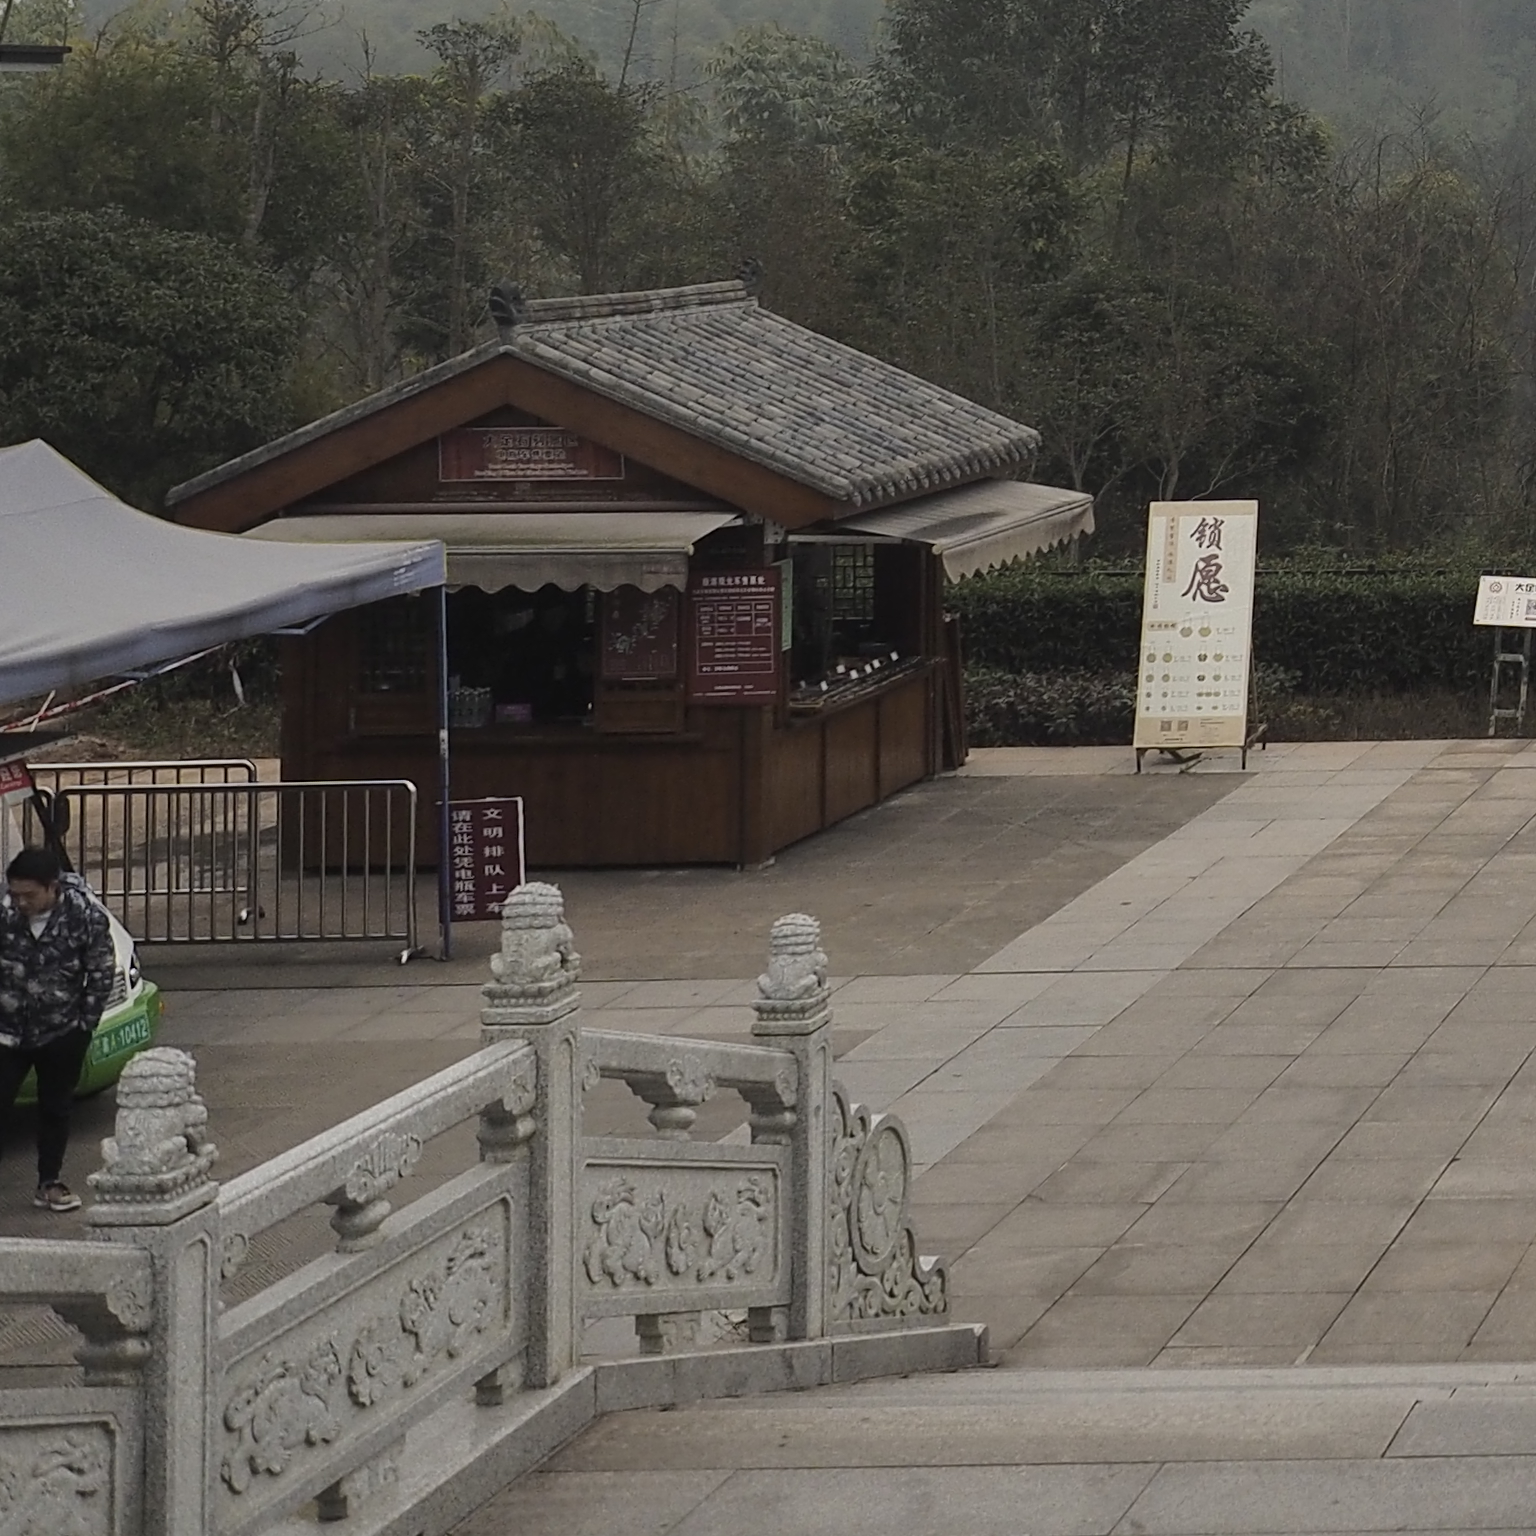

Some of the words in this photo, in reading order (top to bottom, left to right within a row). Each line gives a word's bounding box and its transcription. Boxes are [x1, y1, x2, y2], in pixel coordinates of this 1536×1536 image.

[1181, 517, 1229, 603] 锁愿
[482, 808, 506, 914] 文明排队上车
